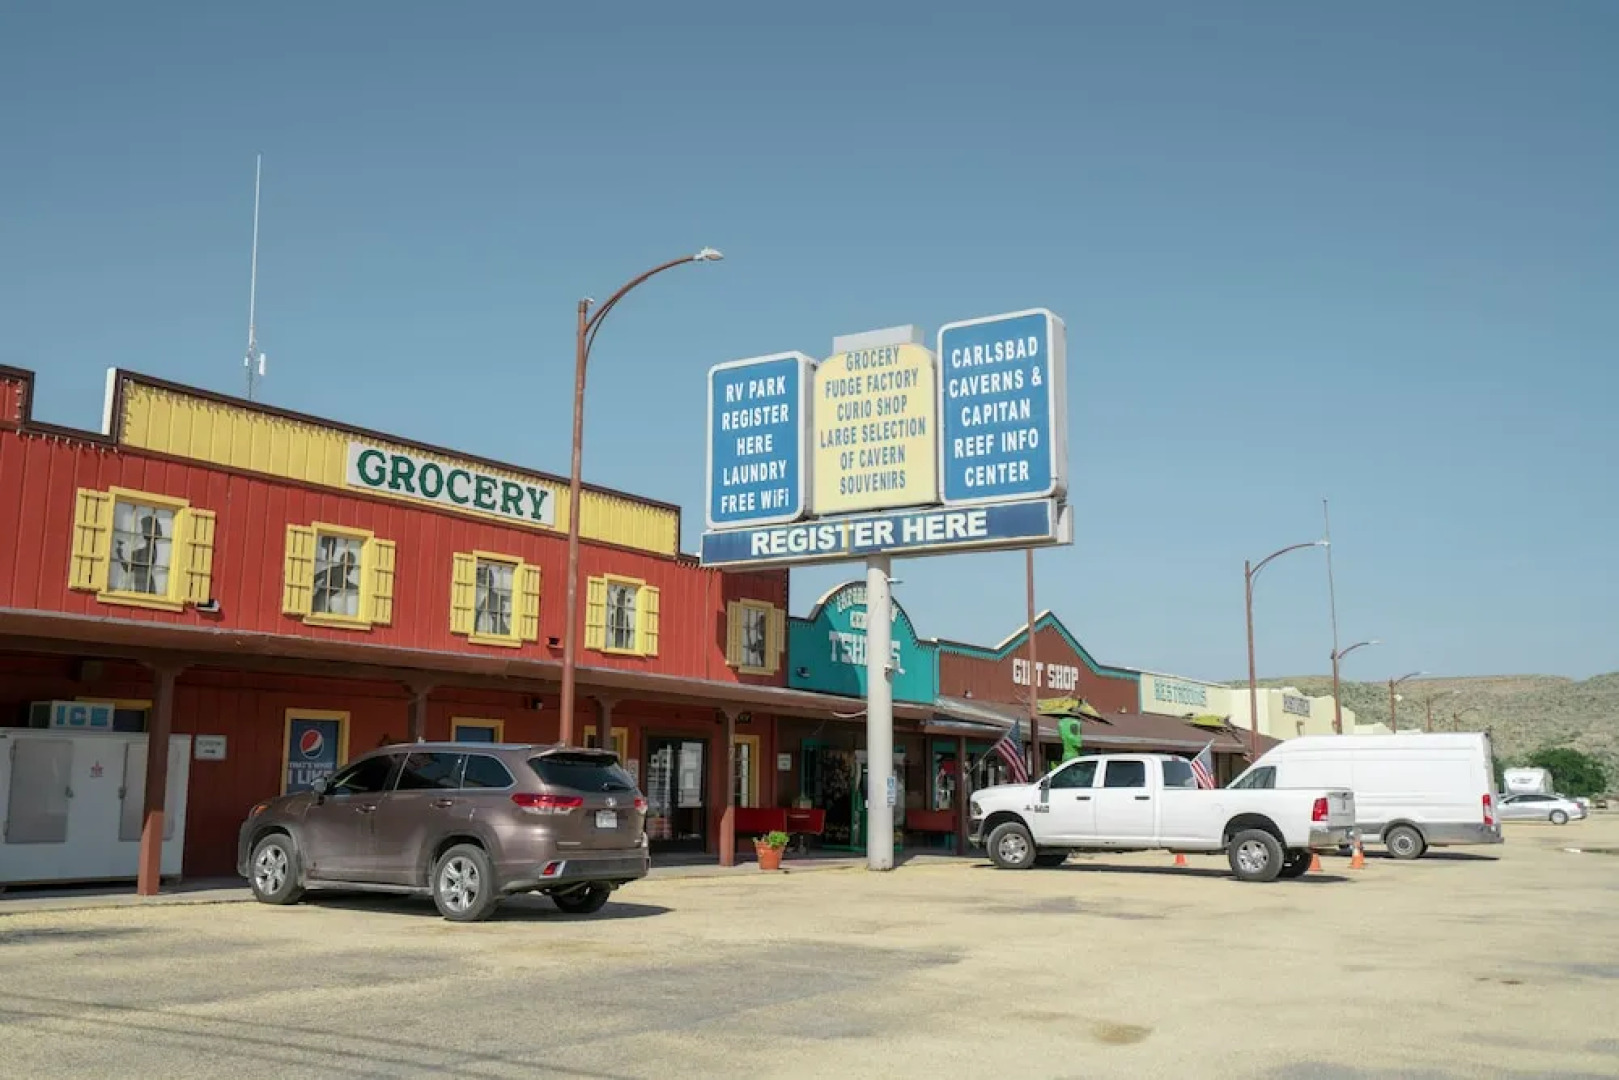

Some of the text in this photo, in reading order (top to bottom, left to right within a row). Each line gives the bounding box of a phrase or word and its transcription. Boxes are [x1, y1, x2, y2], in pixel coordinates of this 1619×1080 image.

[846, 347, 899, 371] GROCERY
[951, 336, 1039, 369] CARLSBAD
[726, 376, 786, 402] RV PARK
[825, 368, 918, 398] FUDGE FACTORY
[949, 365, 1042, 398] CAVERNS &
[722, 403, 789, 431] REGISTER
[837, 395, 907, 421] CURIO SHOP
[961, 398, 1031, 427] CAPITAN
[736, 433, 773, 456] HERE
[820, 416, 926, 448] LARGE SELECTION
[954, 428, 1039, 459] REEF INFO
[840, 445, 906, 470] OF CAVERN
[356, 449, 549, 520] GROCERY
[723, 460, 787, 486] LAUNDRY
[840, 470, 906, 495] SOUVENIRS
[964, 460, 1029, 487] CENTER
[721, 492, 755, 513] FREE
[751, 511, 988, 556] REGISTER HERE
[1013, 658, 1079, 691] GIT SHOP
[56, 705, 109, 727] ICE
